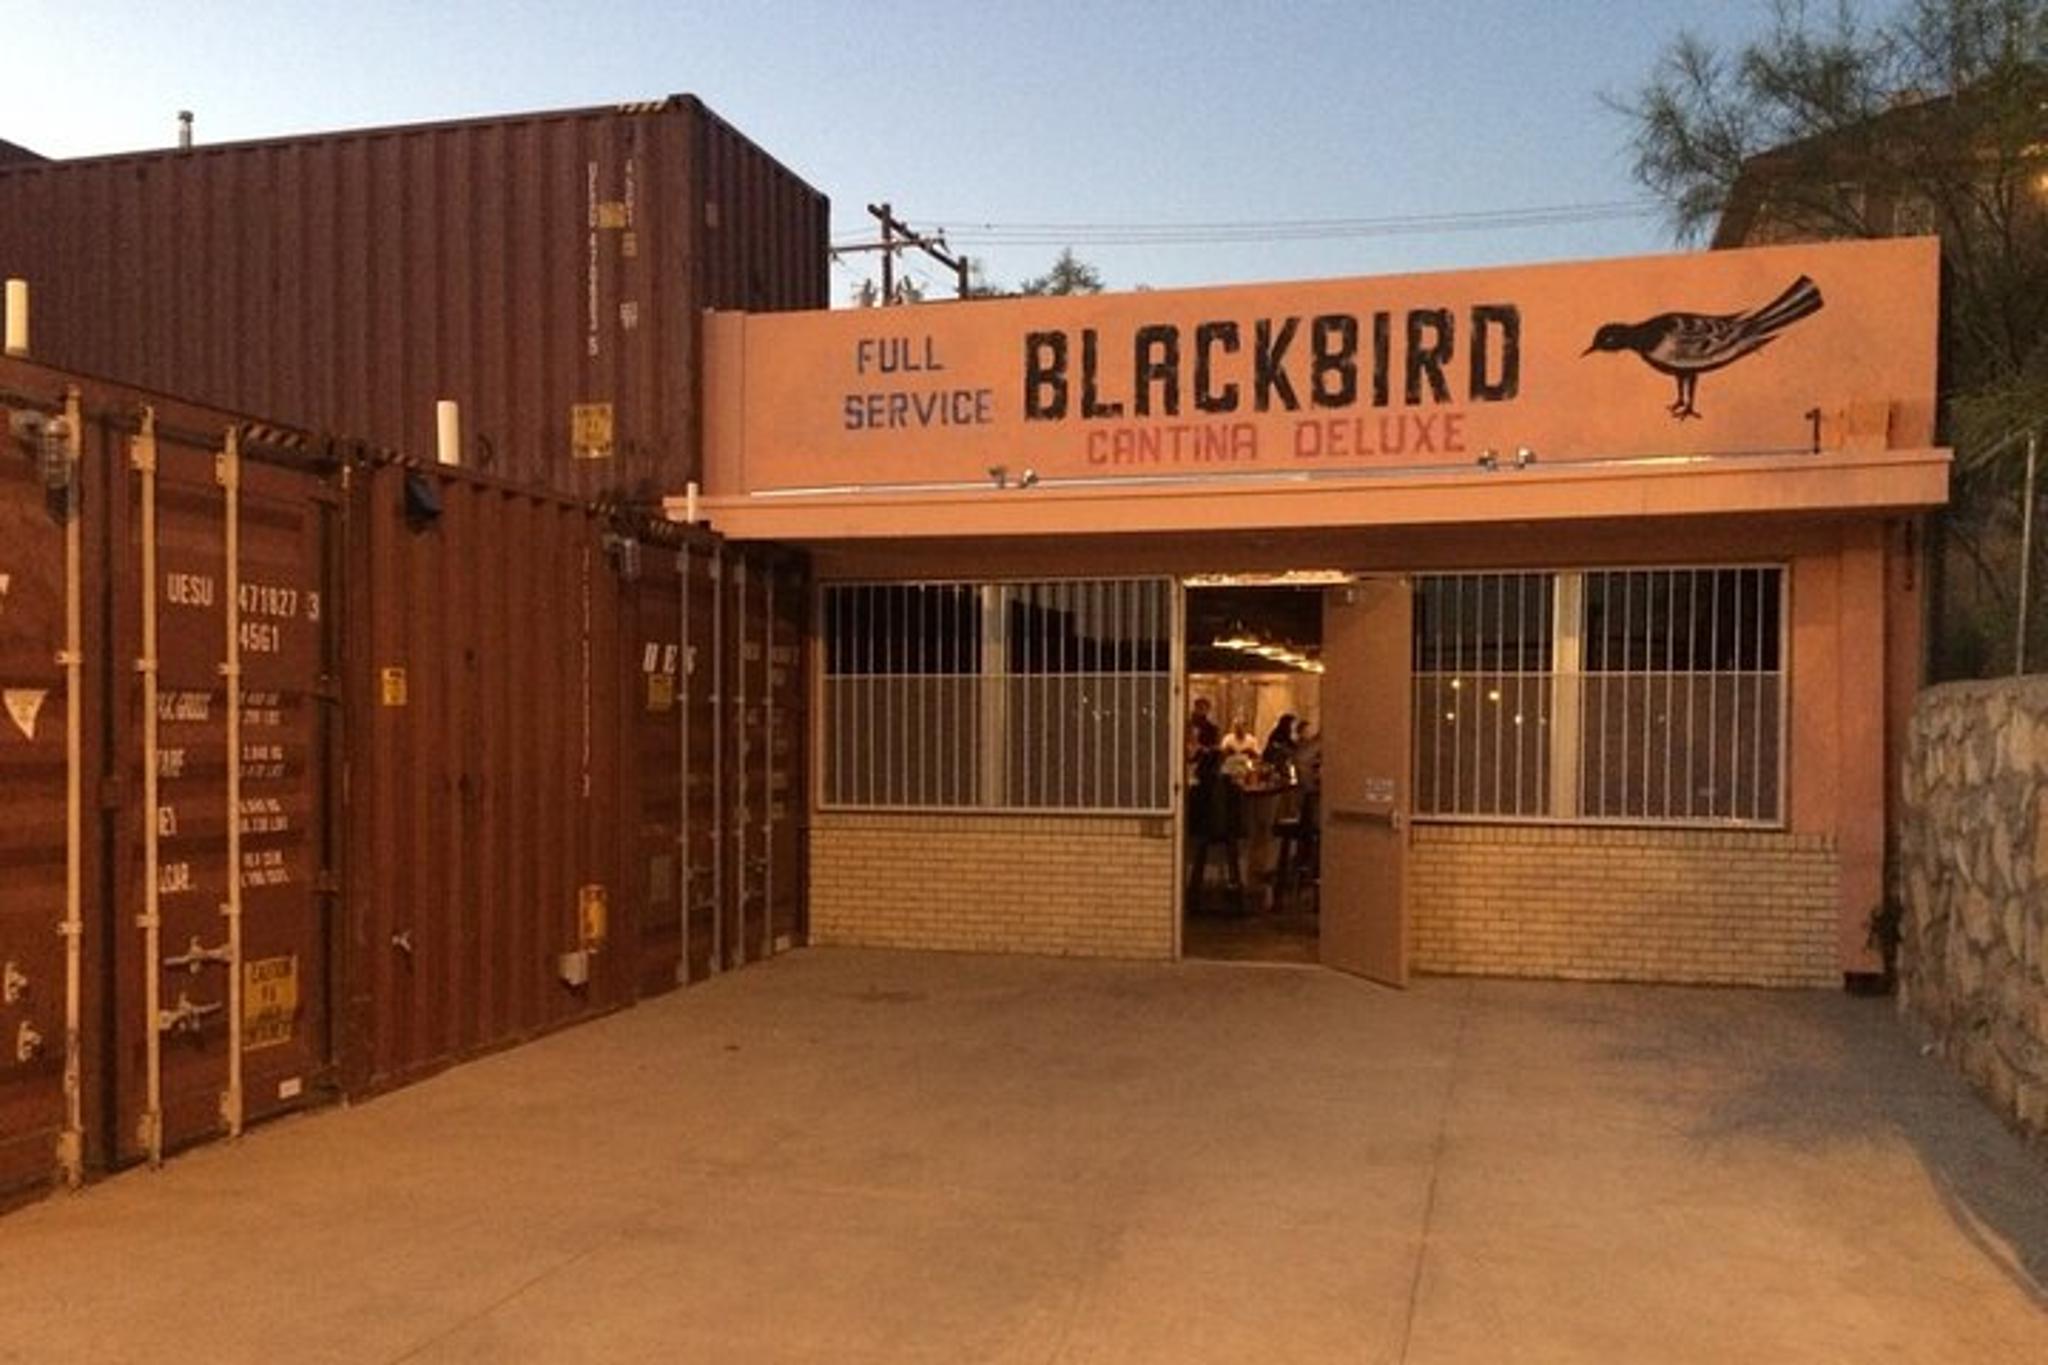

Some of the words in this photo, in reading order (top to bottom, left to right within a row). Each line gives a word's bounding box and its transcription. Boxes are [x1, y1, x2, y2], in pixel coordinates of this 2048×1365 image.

[857, 334, 945, 374] FULL
[1025, 304, 1520, 422] BLACKBIRD
[844, 388, 993, 430] SERVICE
[1087, 422, 1258, 465] CANTINA
[1294, 412, 1466, 458] DELUXE
[167, 572, 214, 607] UESU
[308, 591, 321, 622] 3
